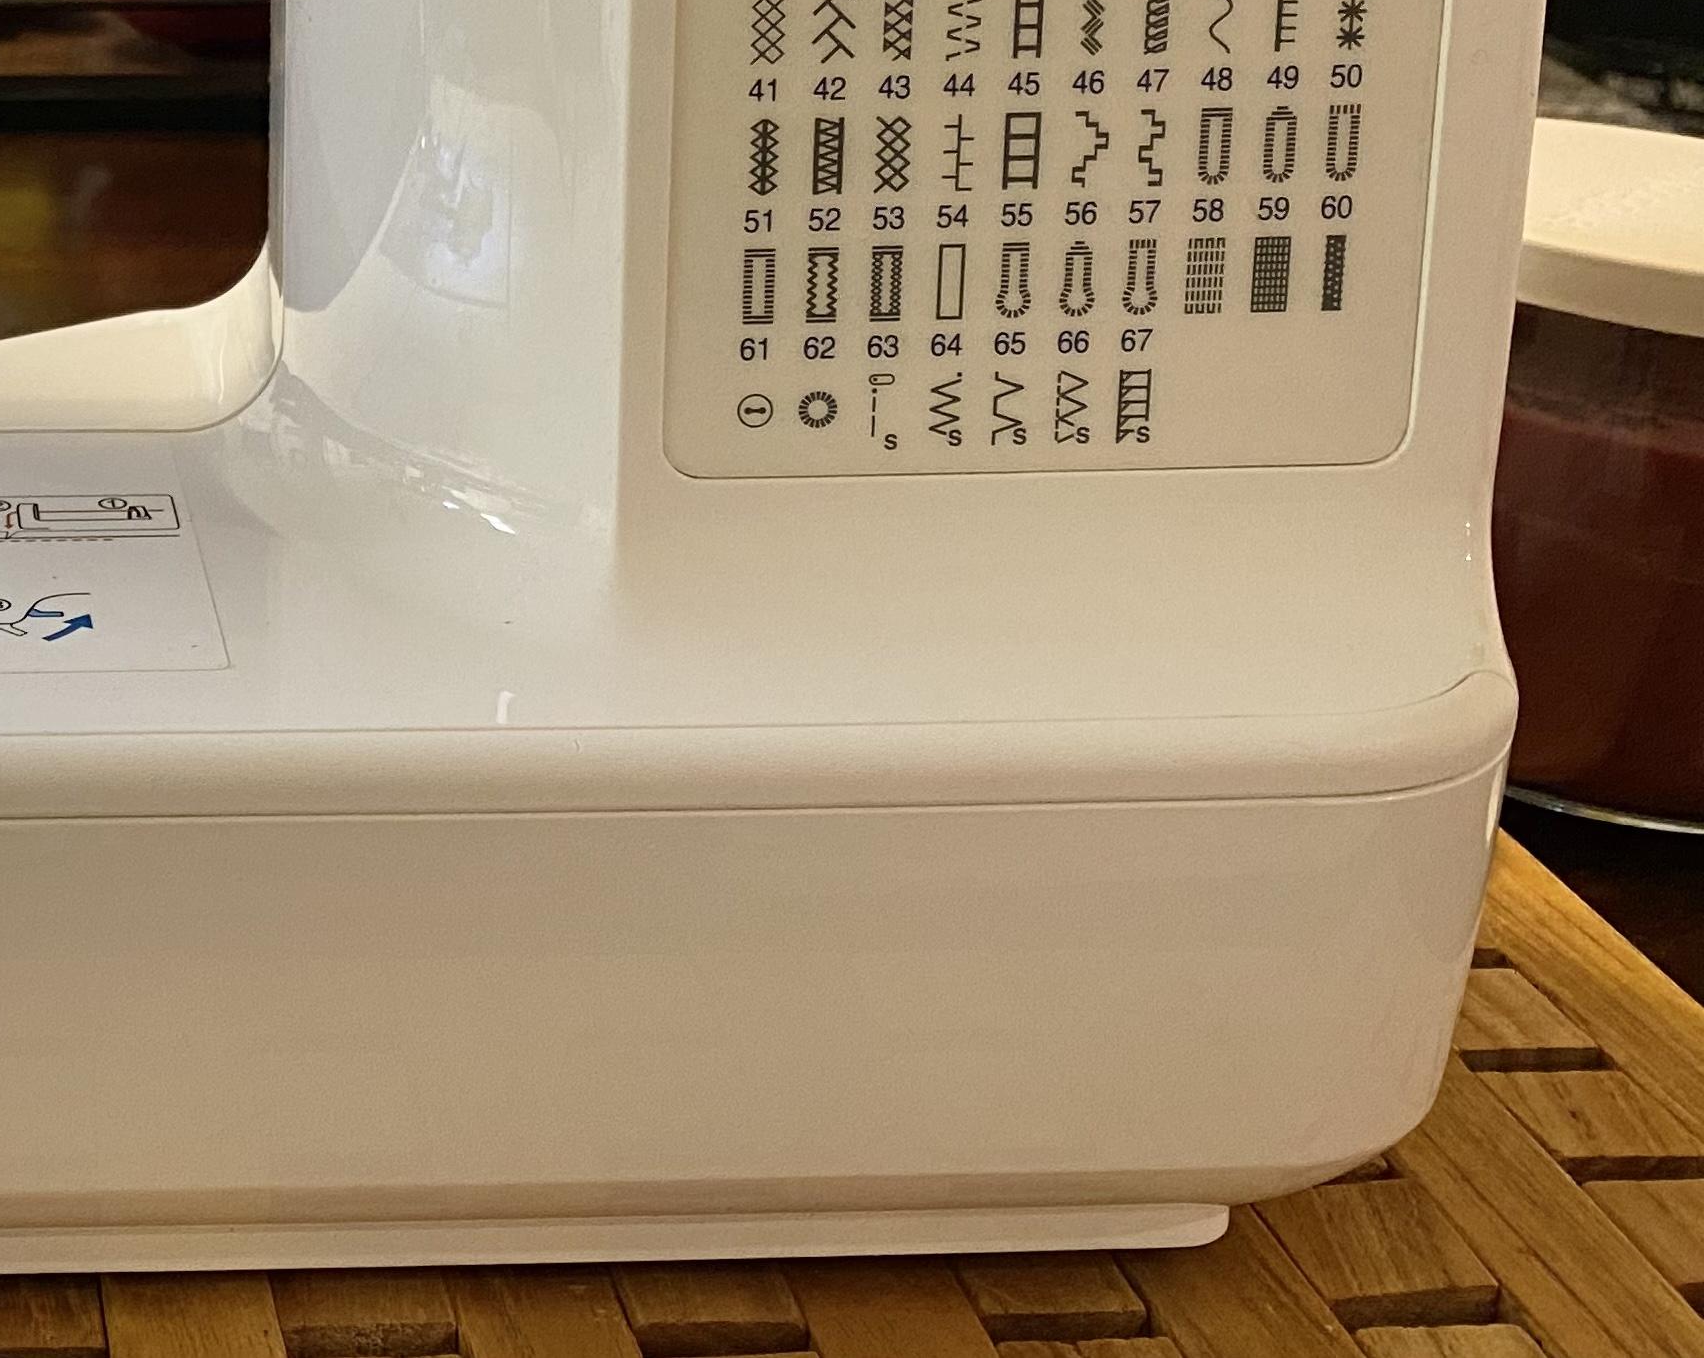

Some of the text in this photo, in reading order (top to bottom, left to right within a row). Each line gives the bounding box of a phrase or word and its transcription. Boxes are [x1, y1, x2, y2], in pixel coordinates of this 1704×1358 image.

[747, 63, 1363, 103] 41 42 43 44 45 46 47 48 49 50
[743, 194, 1354, 234] 51 52 53 54 55 56 57 58 59 60
[739, 327, 1154, 362] 61 62 63 64 65 66 67
